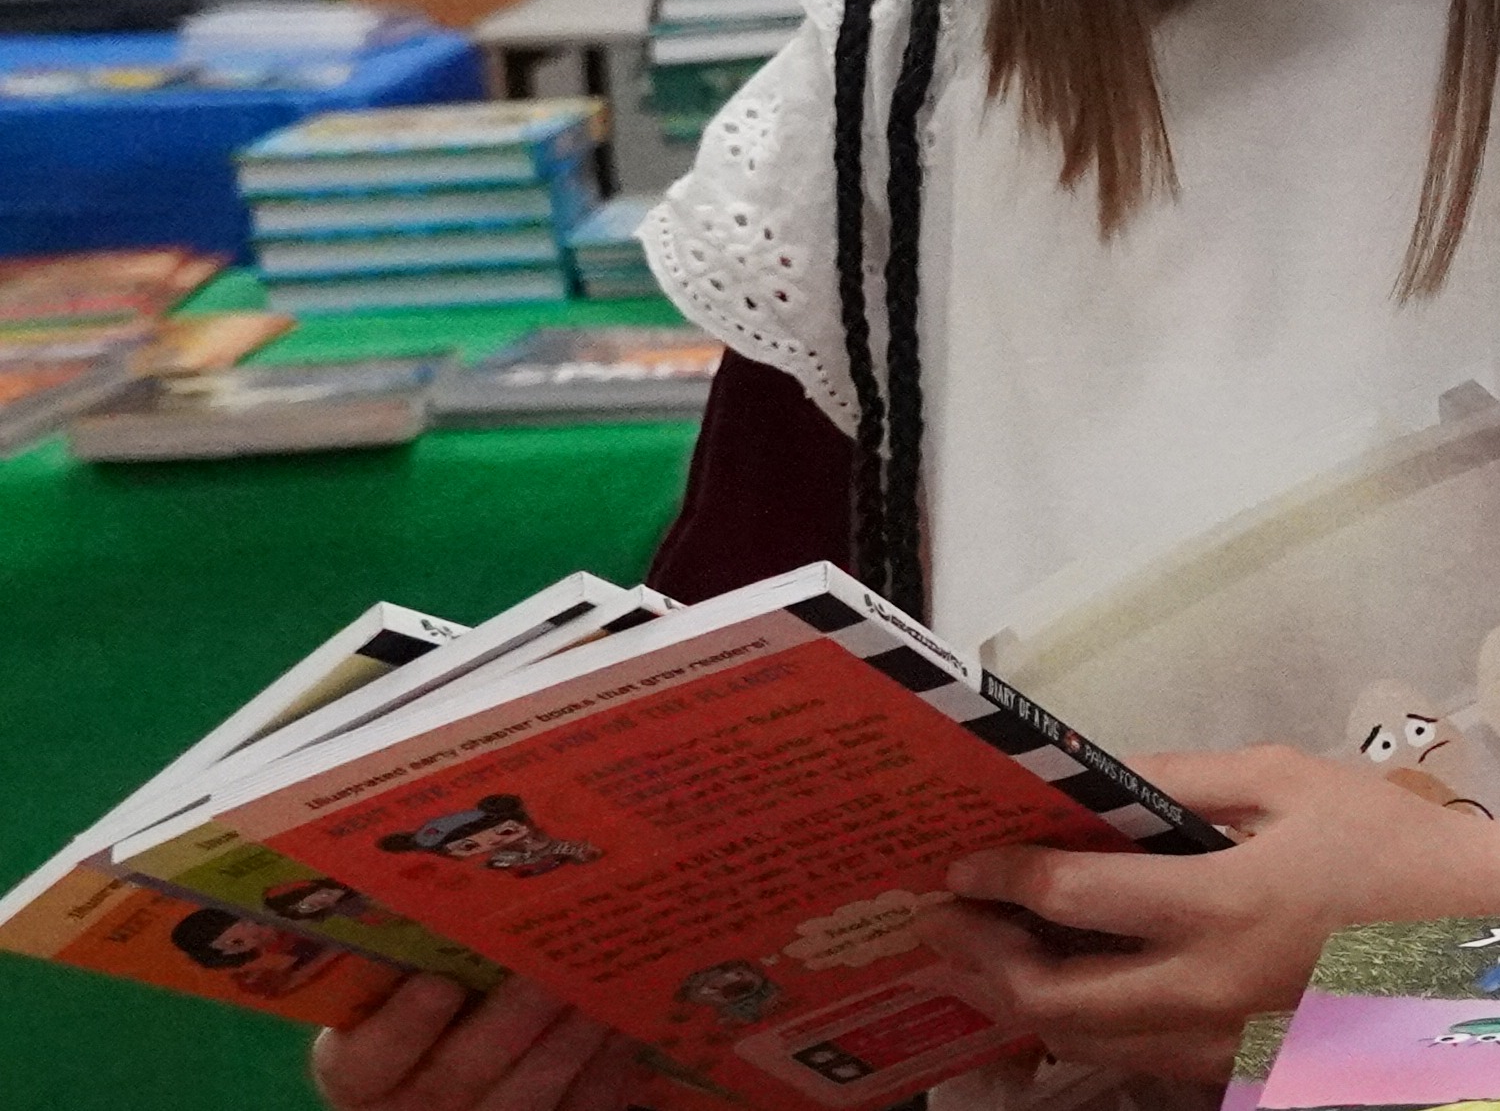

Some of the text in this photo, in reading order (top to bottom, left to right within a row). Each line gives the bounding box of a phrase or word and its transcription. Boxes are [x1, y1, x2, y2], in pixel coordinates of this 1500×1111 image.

[304, 767, 406, 809] Illustrated
[409, 747, 458, 770] early
[460, 719, 533, 751] chapter
[537, 697, 594, 723] books
[597, 681, 636, 702] that
[641, 666, 685, 688] grow
[988, 676, 1060, 741] DIARY OF A PUG
[1084, 744, 1184, 826] PAWS FOR A CAUSE
